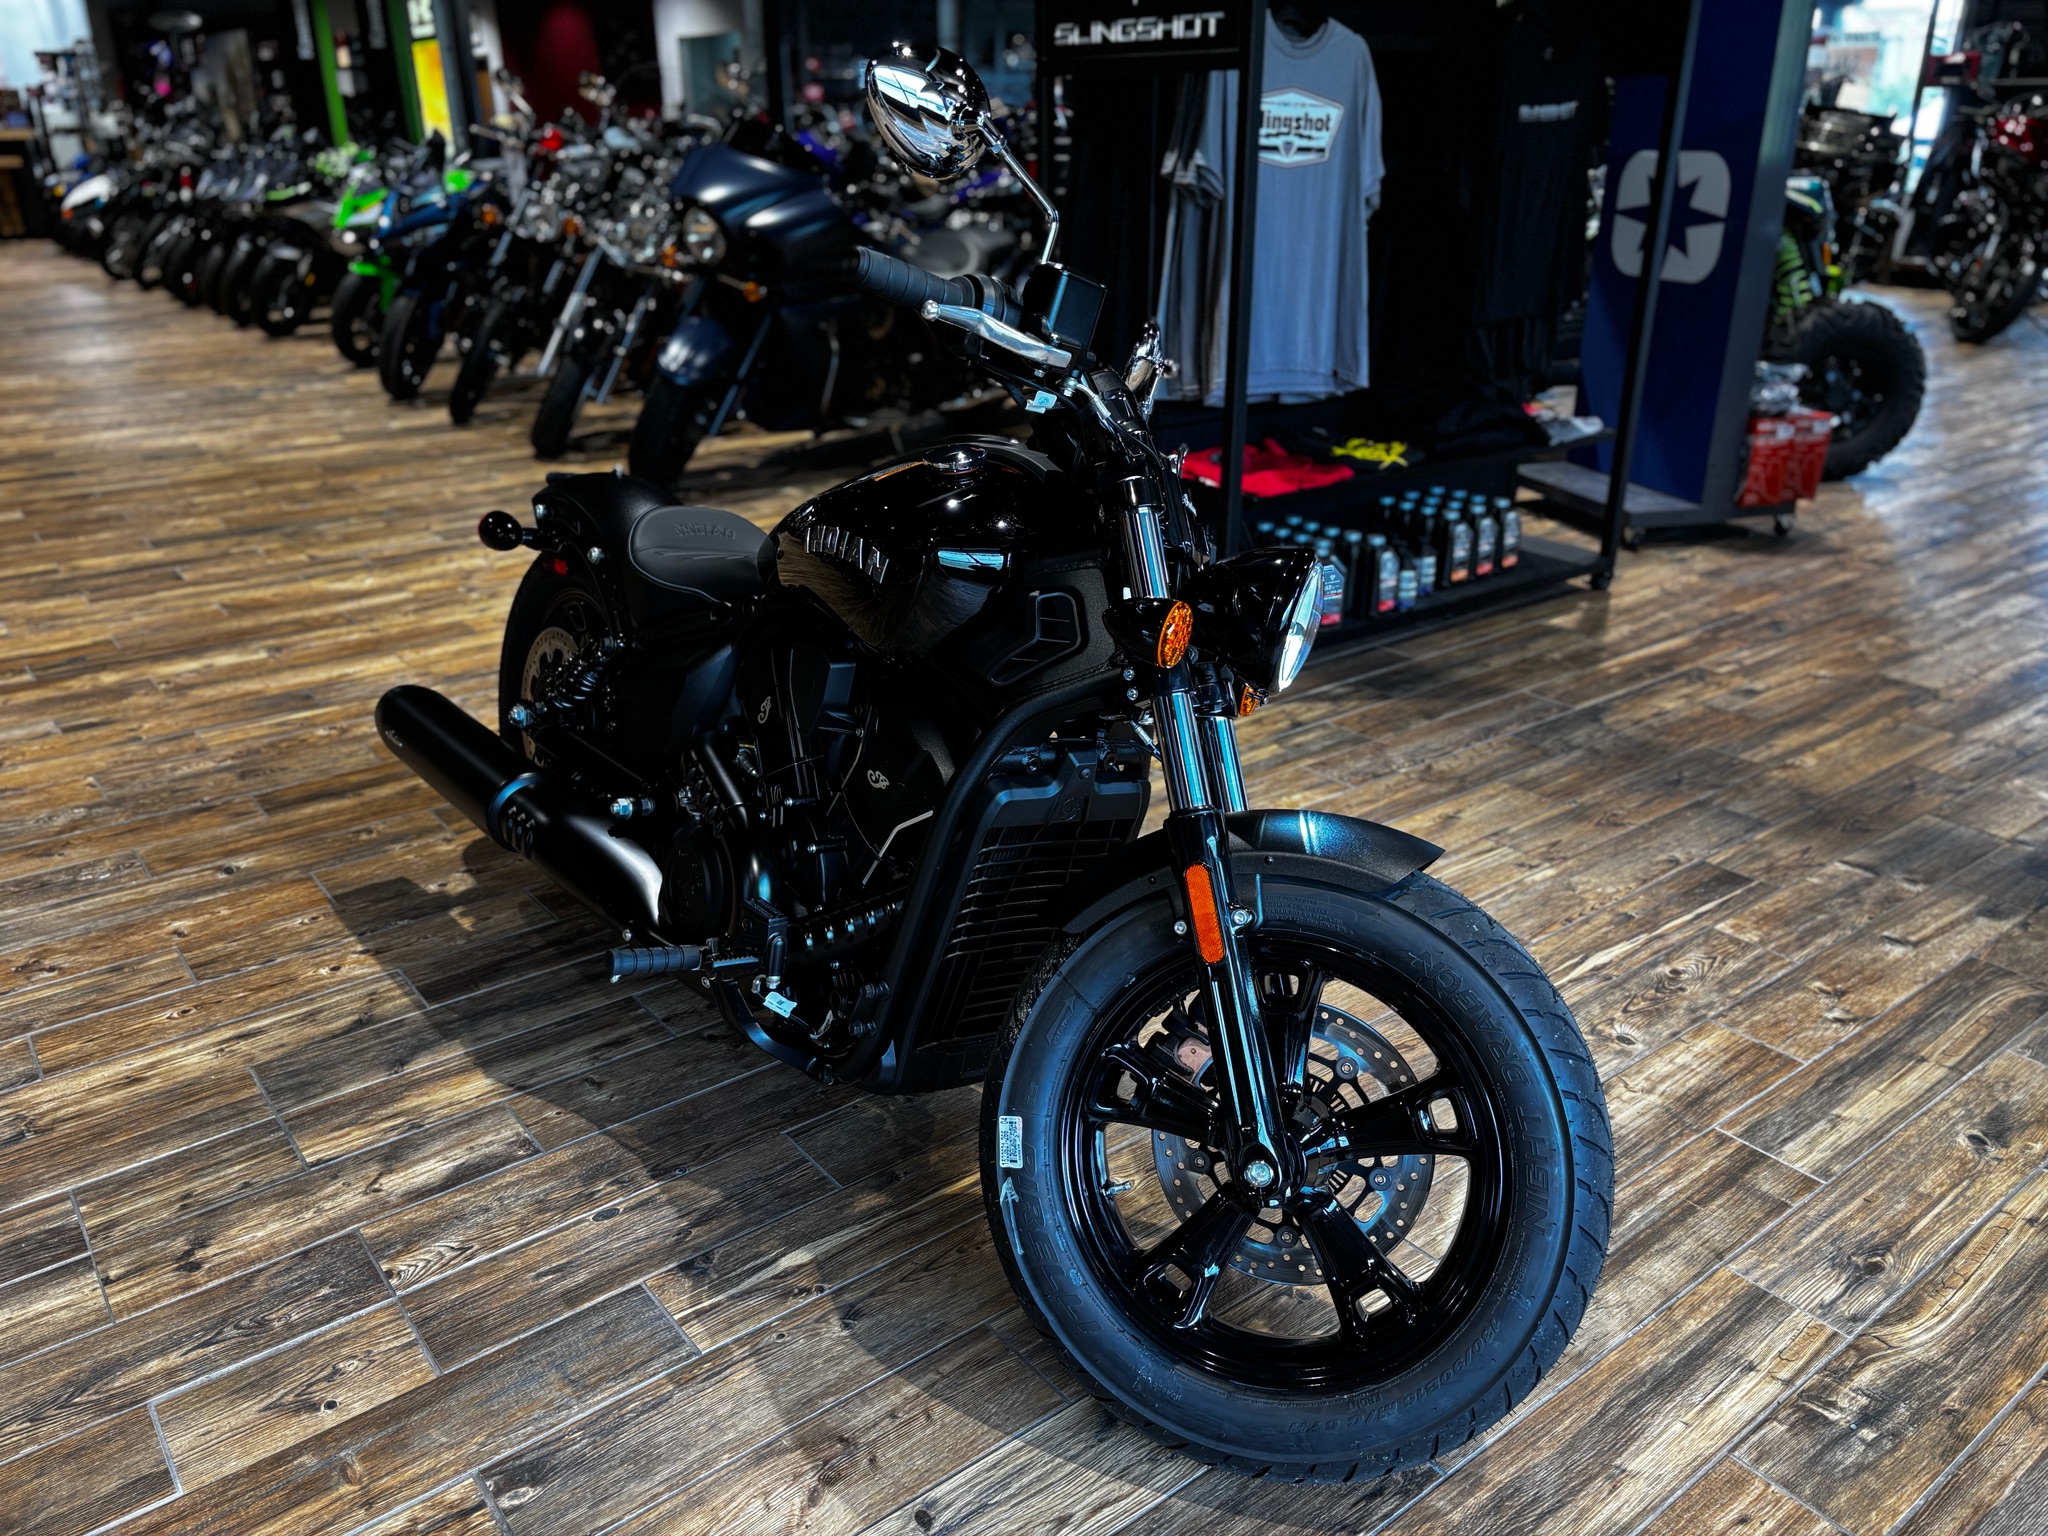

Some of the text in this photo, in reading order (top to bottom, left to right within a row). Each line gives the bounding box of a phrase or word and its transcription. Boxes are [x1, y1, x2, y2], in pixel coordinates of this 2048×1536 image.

[1054, 11, 1225, 46] SLINGSHOT
[1260, 110, 1331, 133] lingshot
[674, 524, 736, 540] INDIAN
[803, 525, 889, 584] INDIAN
[1408, 950, 1550, 1236] NIGHT DRAGON
[1017, 1142, 1104, 1334] PIRELLI
[1287, 1318, 1501, 1434] 130/90B16 M/C 67H
[1347, 1393, 1383, 1412] FRONT
